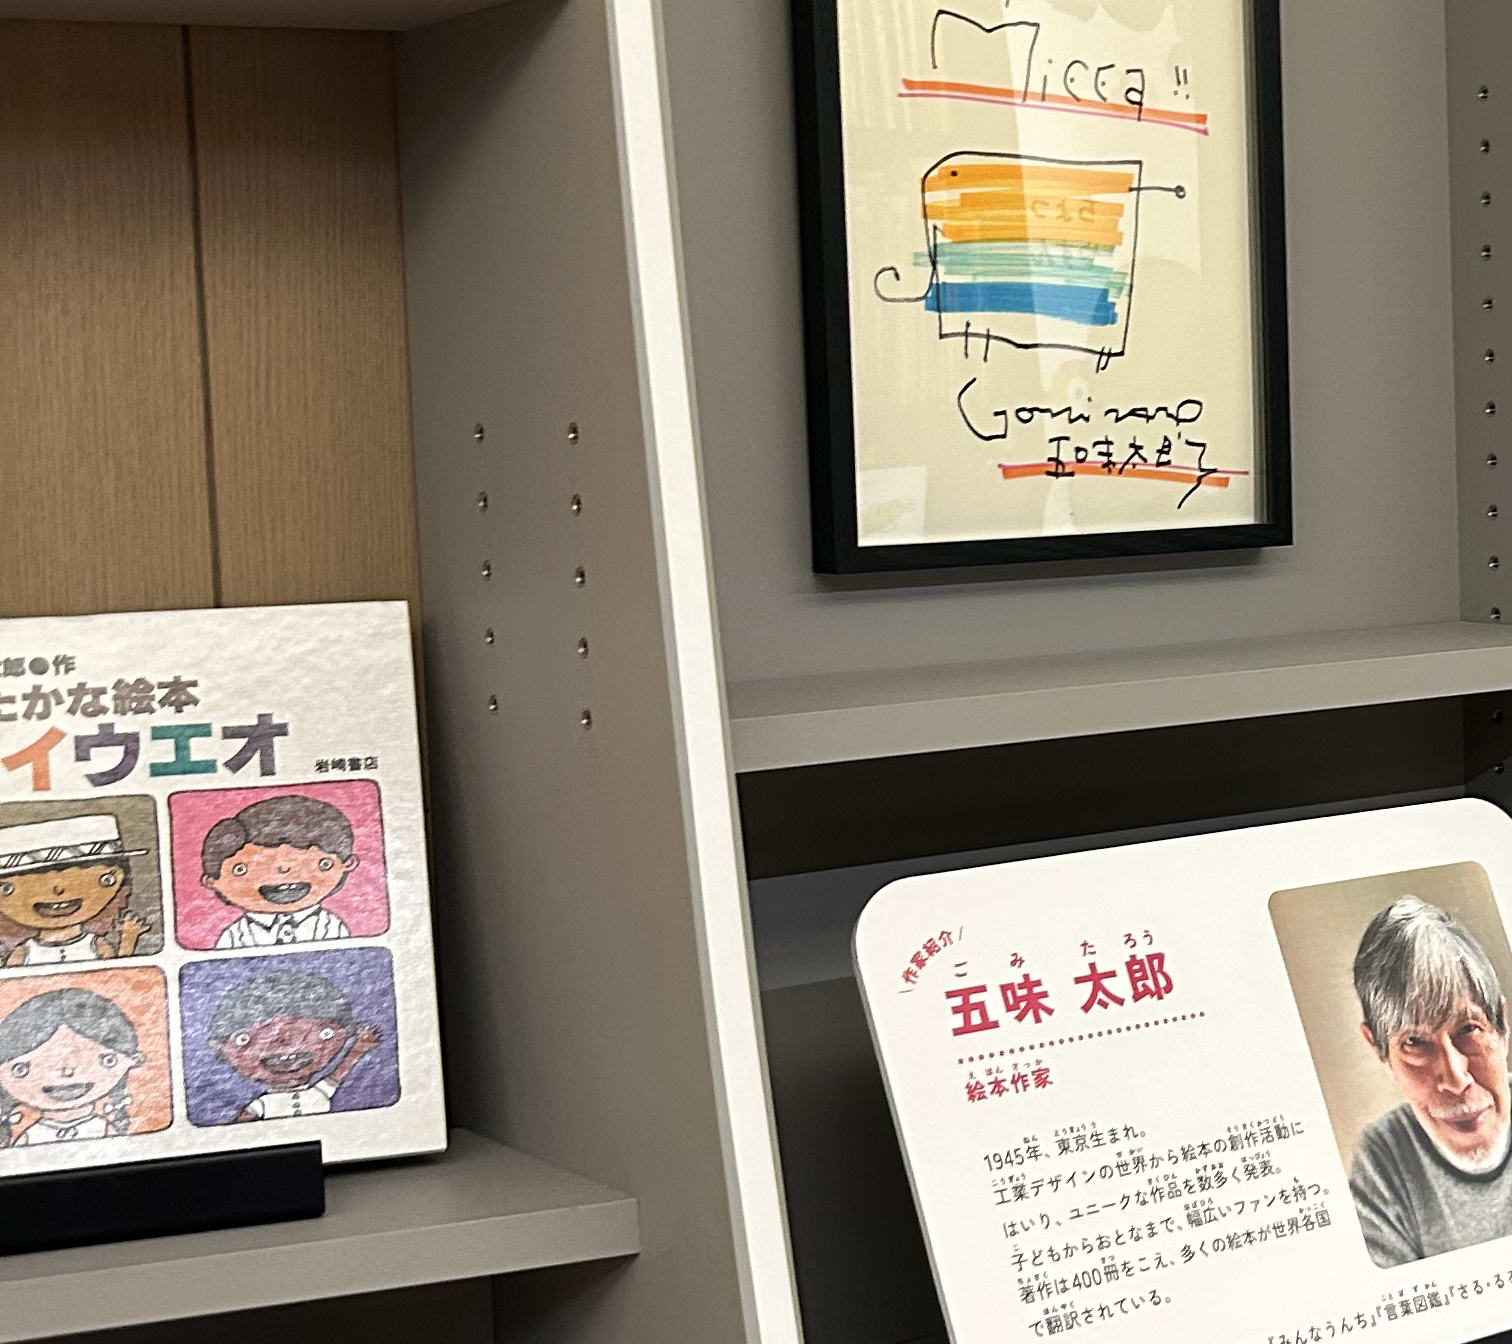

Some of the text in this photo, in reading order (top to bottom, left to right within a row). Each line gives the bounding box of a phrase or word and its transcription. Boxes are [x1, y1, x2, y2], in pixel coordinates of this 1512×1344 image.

[1, 712, 289, 793] イウエオ
[314, 755, 380, 774] 岩崎書店
[901, 929, 954, 985] 作家紹介
[964, 1066, 1054, 1104] 絵本作家
[1028, 1288, 1172, 1338] で翻訳されている。
